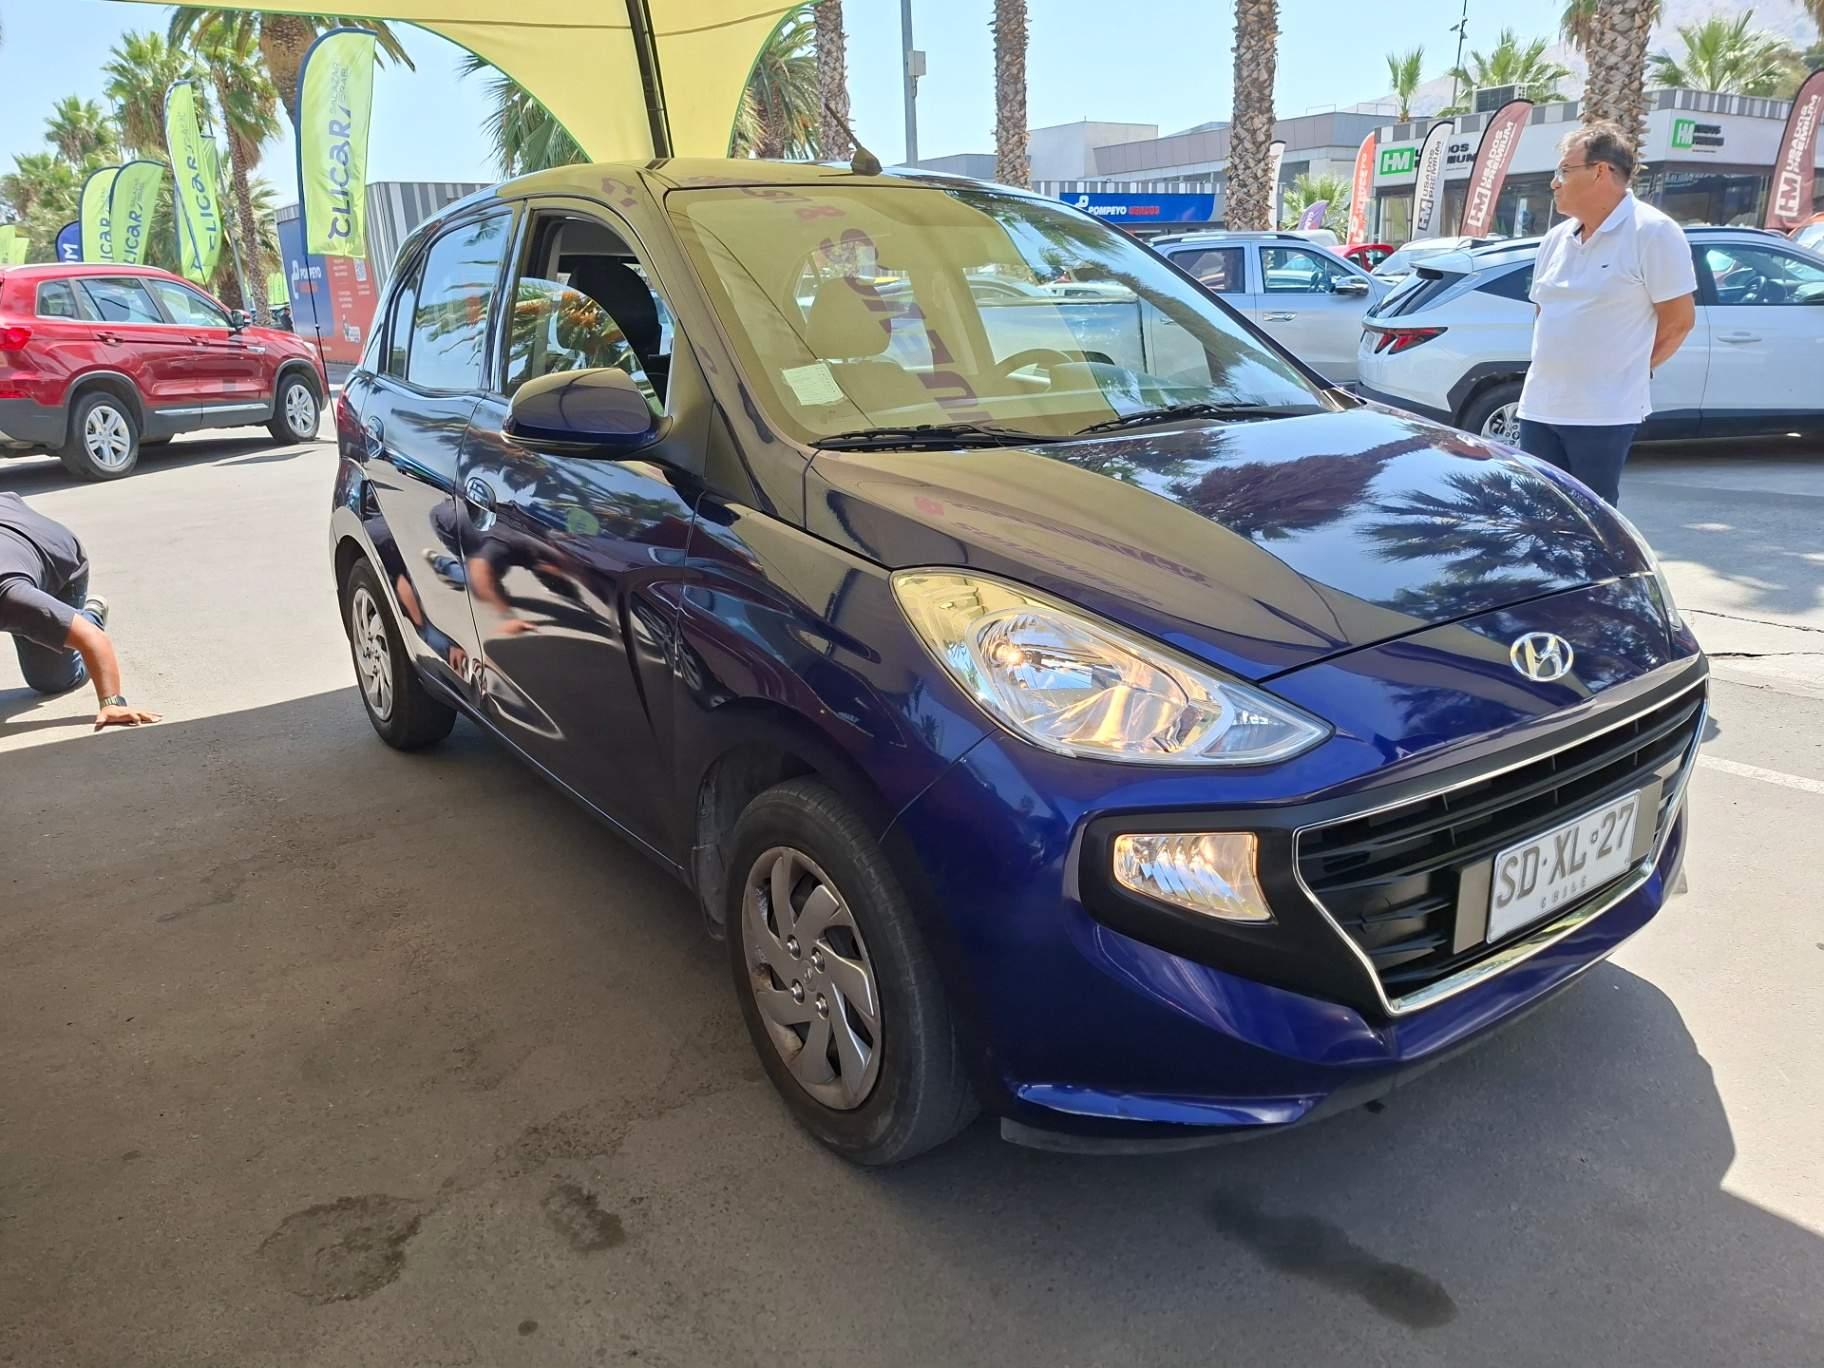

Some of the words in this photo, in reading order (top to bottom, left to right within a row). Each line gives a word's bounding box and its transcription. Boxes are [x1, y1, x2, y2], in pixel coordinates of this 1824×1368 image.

[1382, 150, 1410, 172] HM
[1480, 129, 1503, 187] USADOS
[1486, 121, 1514, 188] PREMIUM
[1423, 149, 1436, 196] USADOS
[1088, 206, 1127, 216] POMPEYO
[1420, 200, 1433, 229] HM
[1469, 189, 1490, 224] HM
